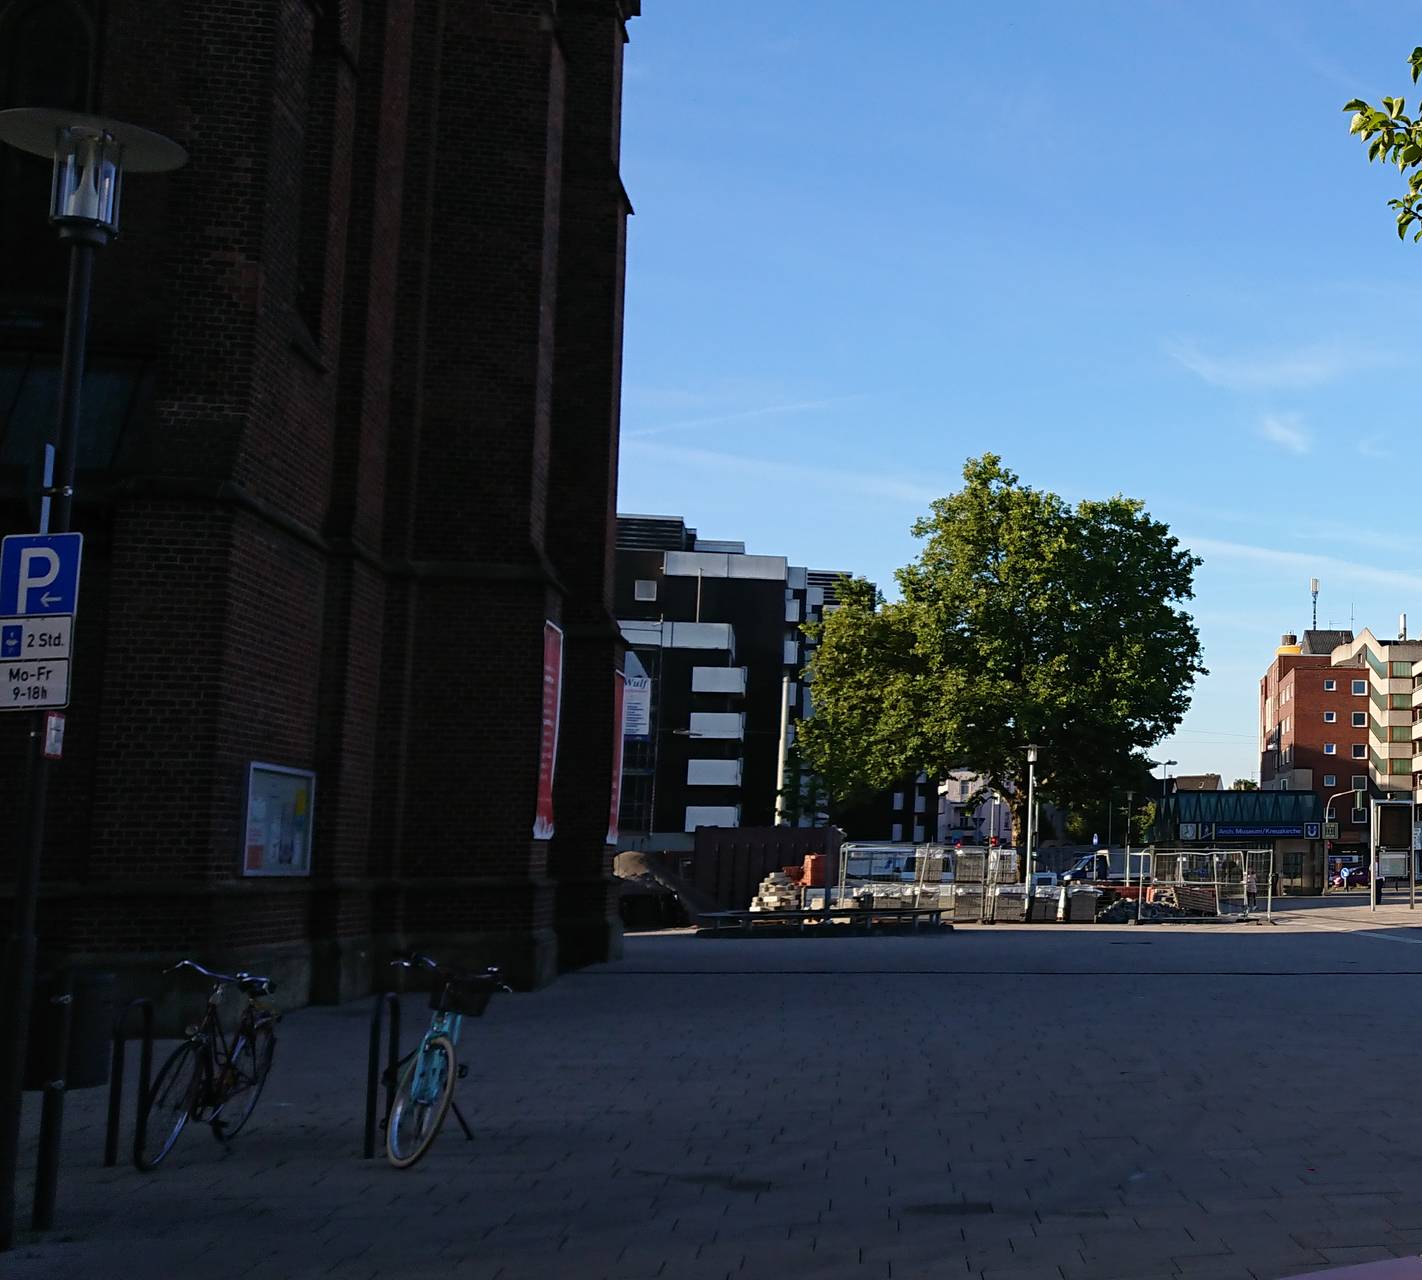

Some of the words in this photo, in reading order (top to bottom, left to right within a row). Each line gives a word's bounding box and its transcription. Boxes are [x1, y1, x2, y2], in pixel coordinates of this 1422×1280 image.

[16, 547, 60, 614] P
[26, 634, 36, 648] 2
[38, 631, 65, 647] Std.
[8, 665, 53, 683] Mo-Fr
[12, 685, 48, 701] 9-18h
